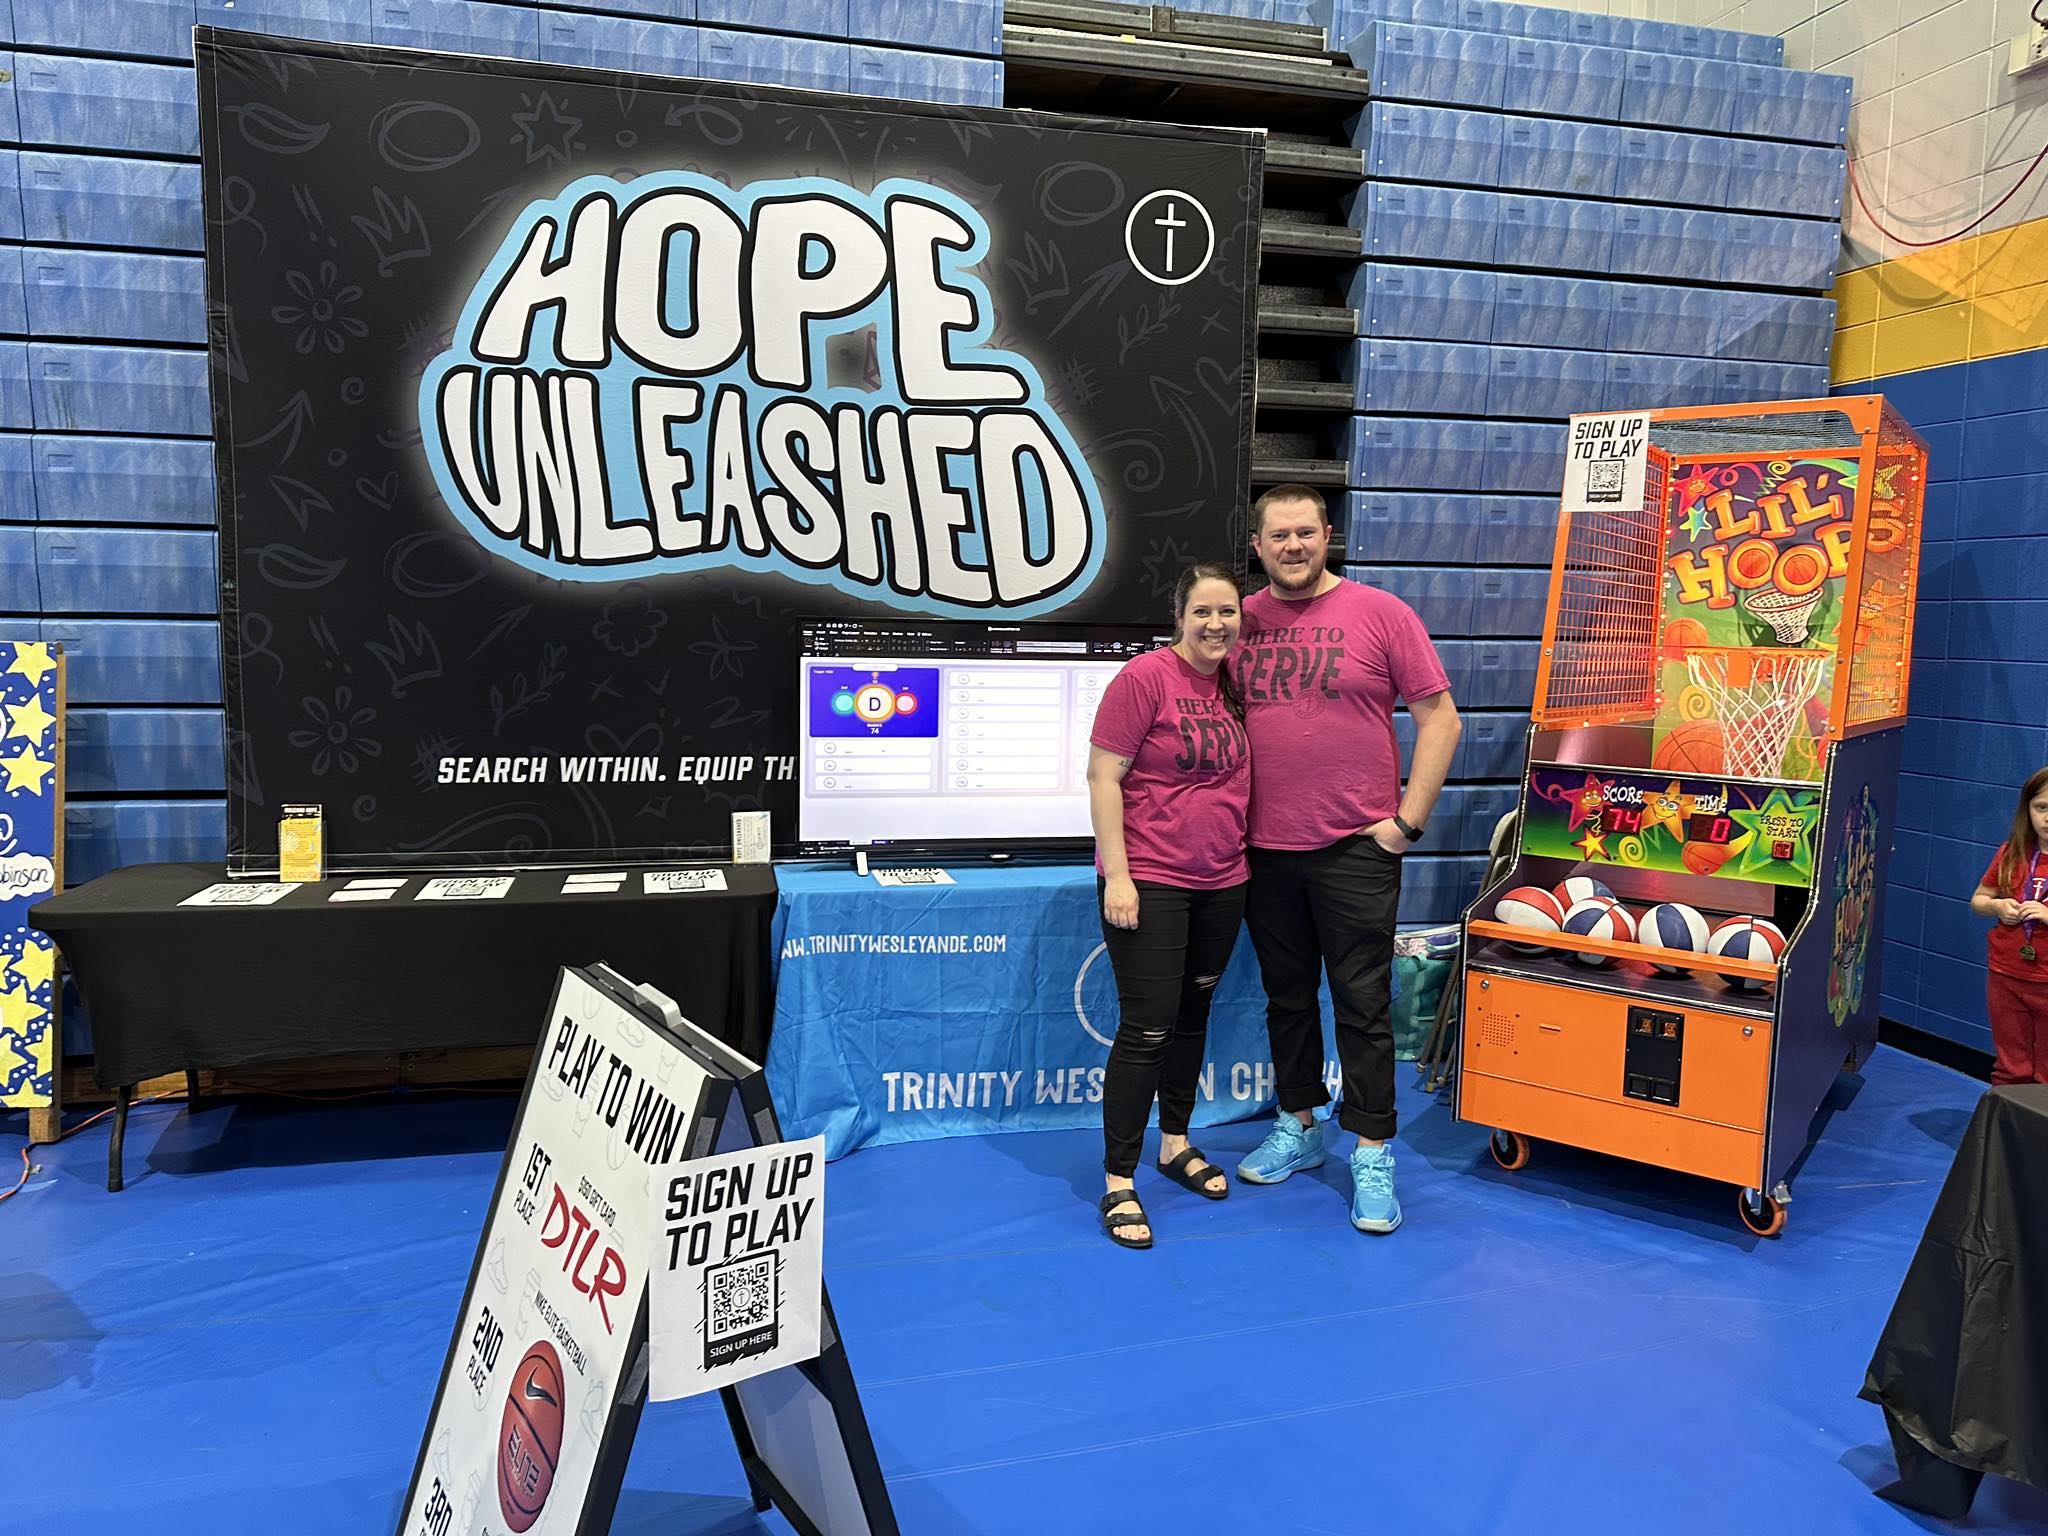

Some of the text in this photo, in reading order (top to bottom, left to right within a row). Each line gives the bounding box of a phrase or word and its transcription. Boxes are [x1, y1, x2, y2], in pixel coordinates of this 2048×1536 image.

[471, 187, 1029, 406] HOPE
[1574, 438, 1643, 460] TO PLAY
[1575, 418, 1643, 440] SIGN UP
[437, 364, 1092, 608] UNLEASHED
[1244, 626, 1345, 647] HERE TO
[1237, 646, 1345, 701] SERVE
[868, 696, 882, 712] D
[870, 727, 880, 735] 74
[1174, 715, 1247, 771] SERV
[437, 755, 797, 786] SEARCH WITHIN. EQUIP TH
[1602, 784, 1644, 805] SCORE
[1694, 794, 1729, 813] TIME
[1608, 807, 1642, 833] 74
[1759, 815, 1804, 829] PRESS TO
[1766, 826, 1800, 839] START
[548, 1015, 685, 1165] PLAY TO WIN
[882, 1070, 1022, 1112] TRINITY
[522, 1142, 552, 1197] 1ST
[665, 1152, 814, 1222] SIGN UP
[513, 1189, 536, 1226] PLACE
[665, 1197, 816, 1271] TO PLAY
[540, 1181, 627, 1336] DTLR
[472, 1305, 504, 1373] 2ND
[543, 1304, 561, 1334] ELITE
[555, 1322, 588, 1377] BASKETBALL
[709, 1330, 773, 1358] SIGN UP HERE
[465, 1354, 487, 1396] PLACE
[424, 1476, 453, 1536] 3RD
